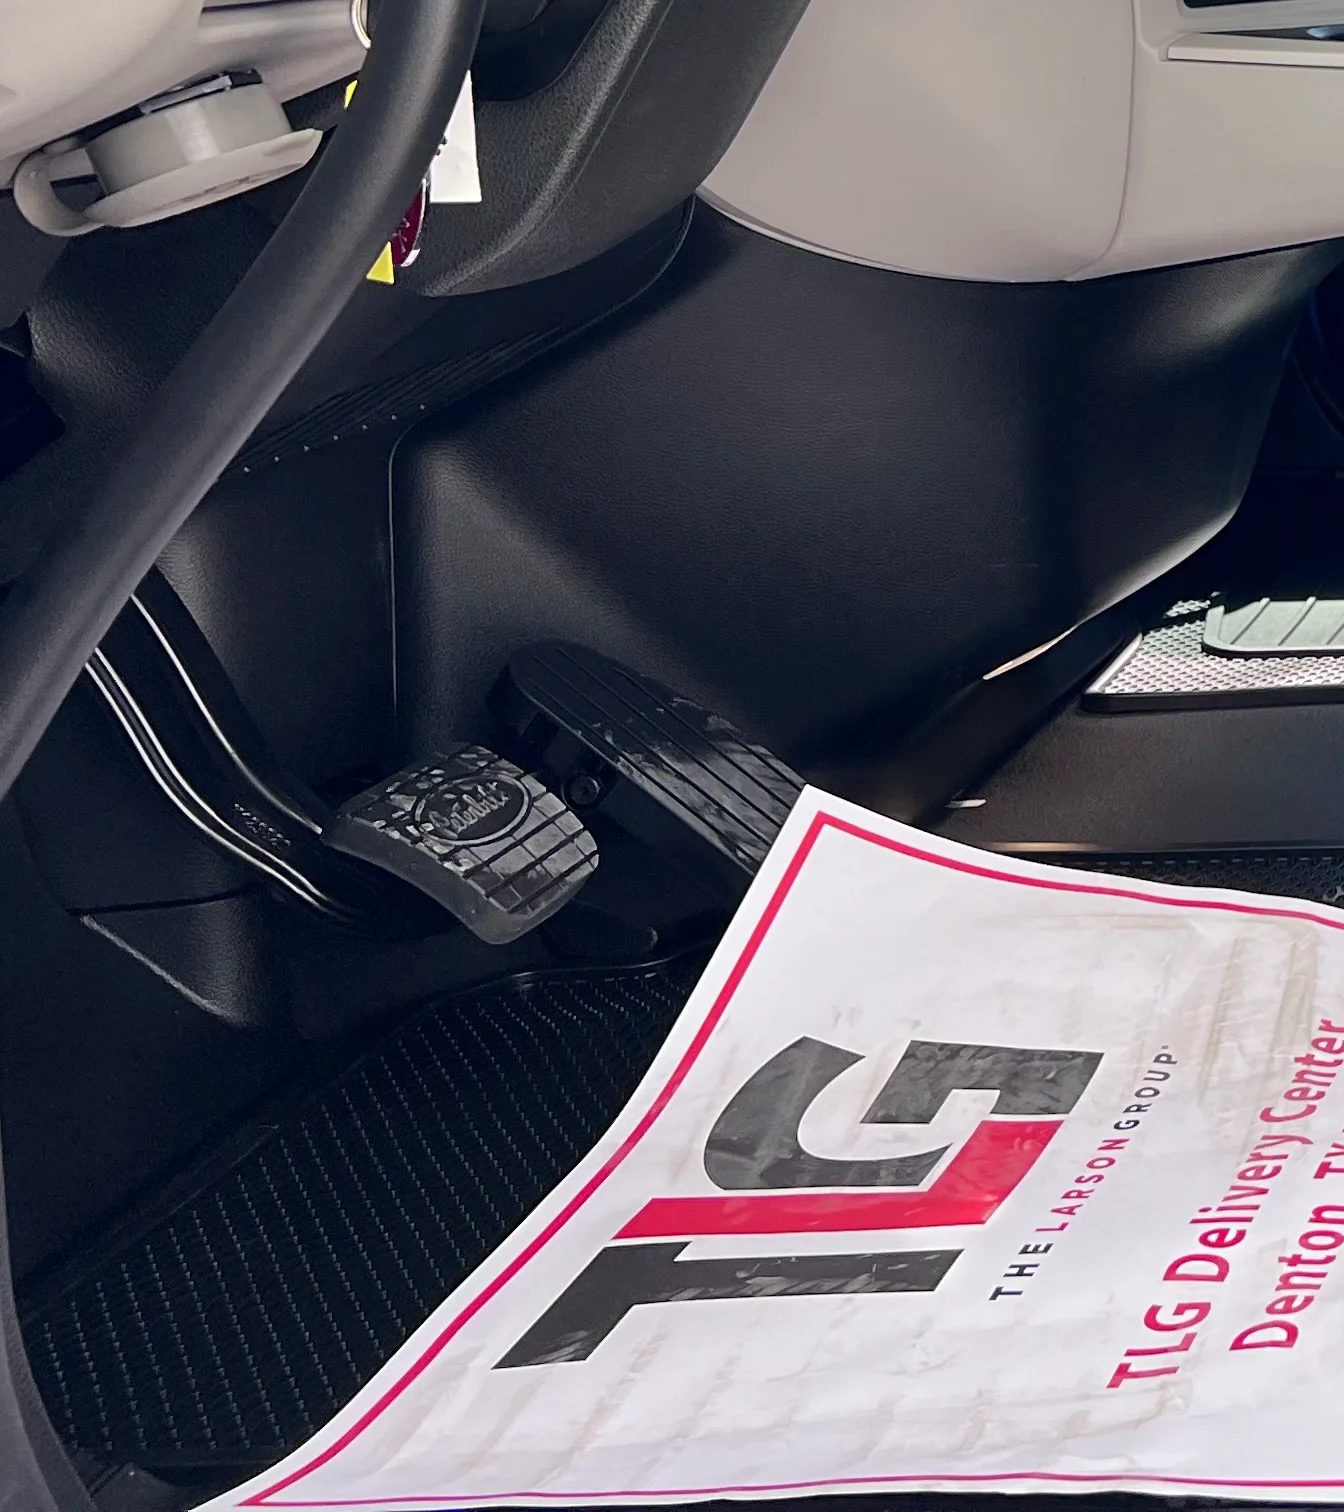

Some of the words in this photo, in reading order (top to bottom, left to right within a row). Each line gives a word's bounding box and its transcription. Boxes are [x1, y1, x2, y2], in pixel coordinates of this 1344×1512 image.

[490, 1035, 1105, 1370] TLG
[989, 1240, 1055, 1302] THE
[1035, 1136, 1131, 1235] LARSON
[1113, 1051, 1179, 1132] GROUP
[1106, 1300, 1213, 1390] TLG
[1162, 1128, 1313, 1284] Delivery
